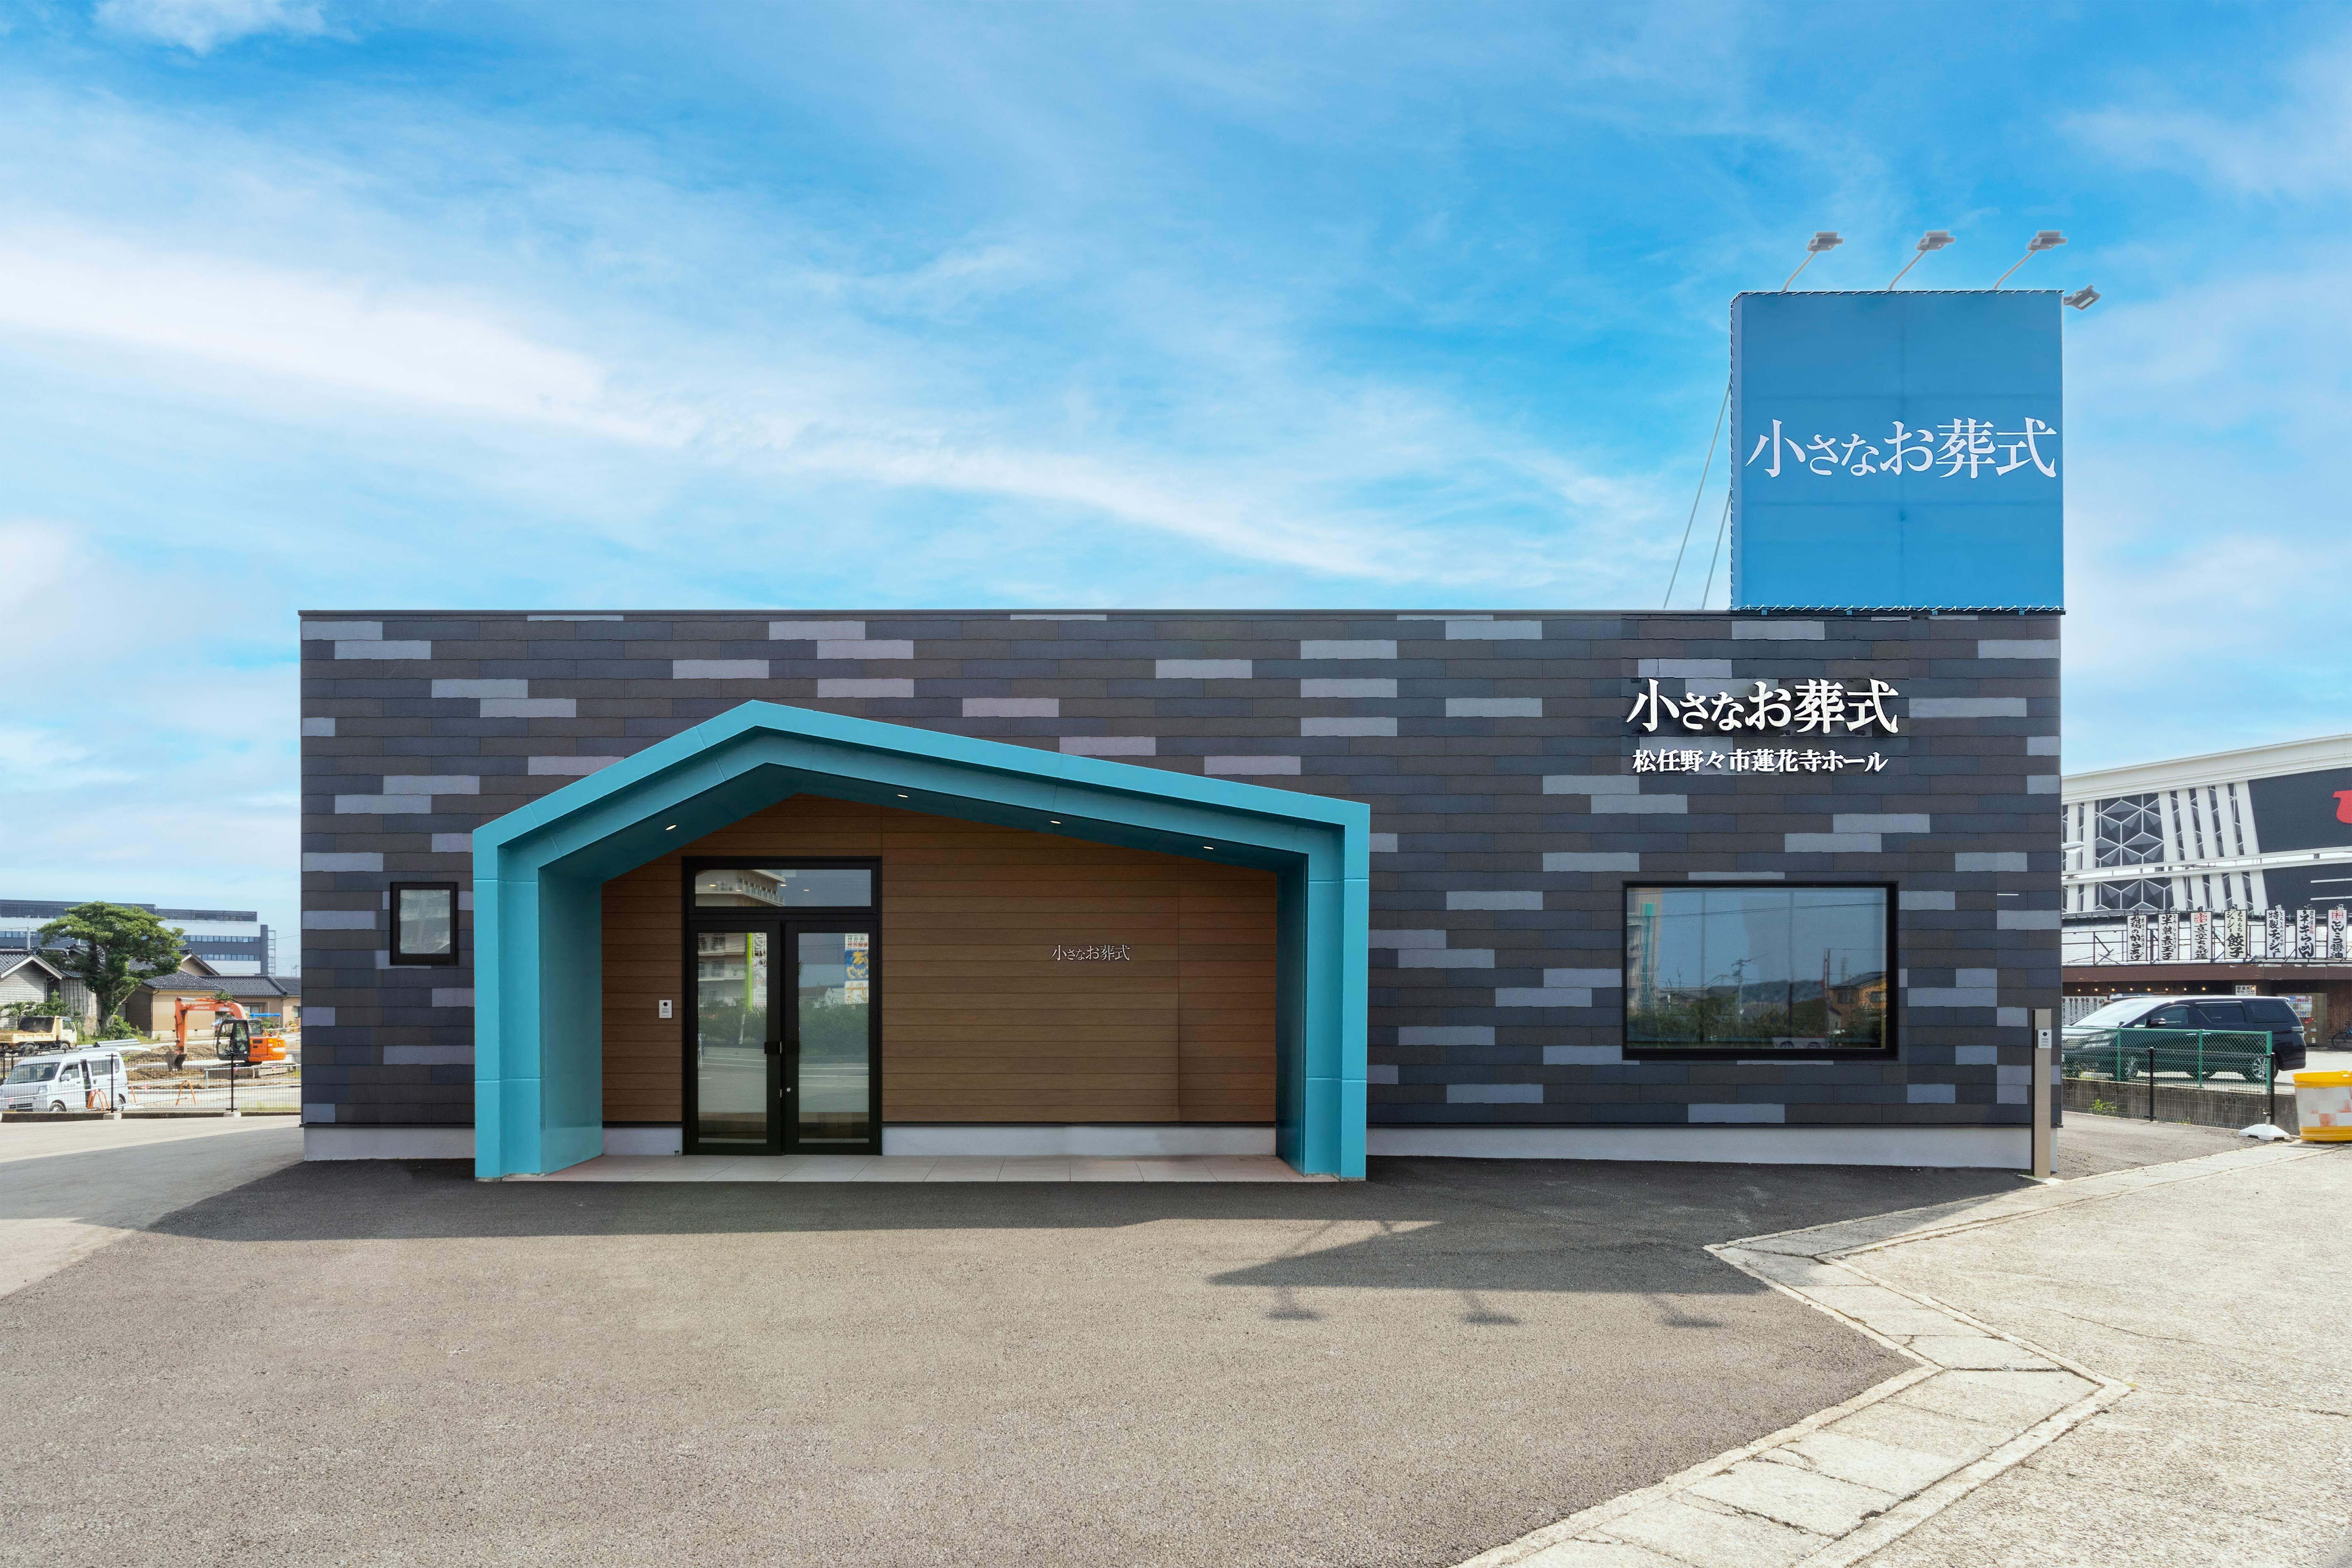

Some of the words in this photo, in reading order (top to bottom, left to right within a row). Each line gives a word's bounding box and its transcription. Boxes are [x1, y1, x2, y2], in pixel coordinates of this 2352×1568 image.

[1745, 417, 2057, 478] 小さなお葬式
[1625, 678, 1899, 733] 小さなお葬式
[1632, 749, 1889, 772] 松任野々市蓮花寺ホール
[1051, 944, 1130, 961] 小さなお葬式
[2161, 914, 2174, 960] 半熟煮玉子
[2226, 933, 2245, 958] 餃子
[2269, 911, 2281, 958] 特製チャーシュー
[2298, 910, 2314, 958] ネギらーめん
[2330, 920, 2345, 958] とんこつ醤油
